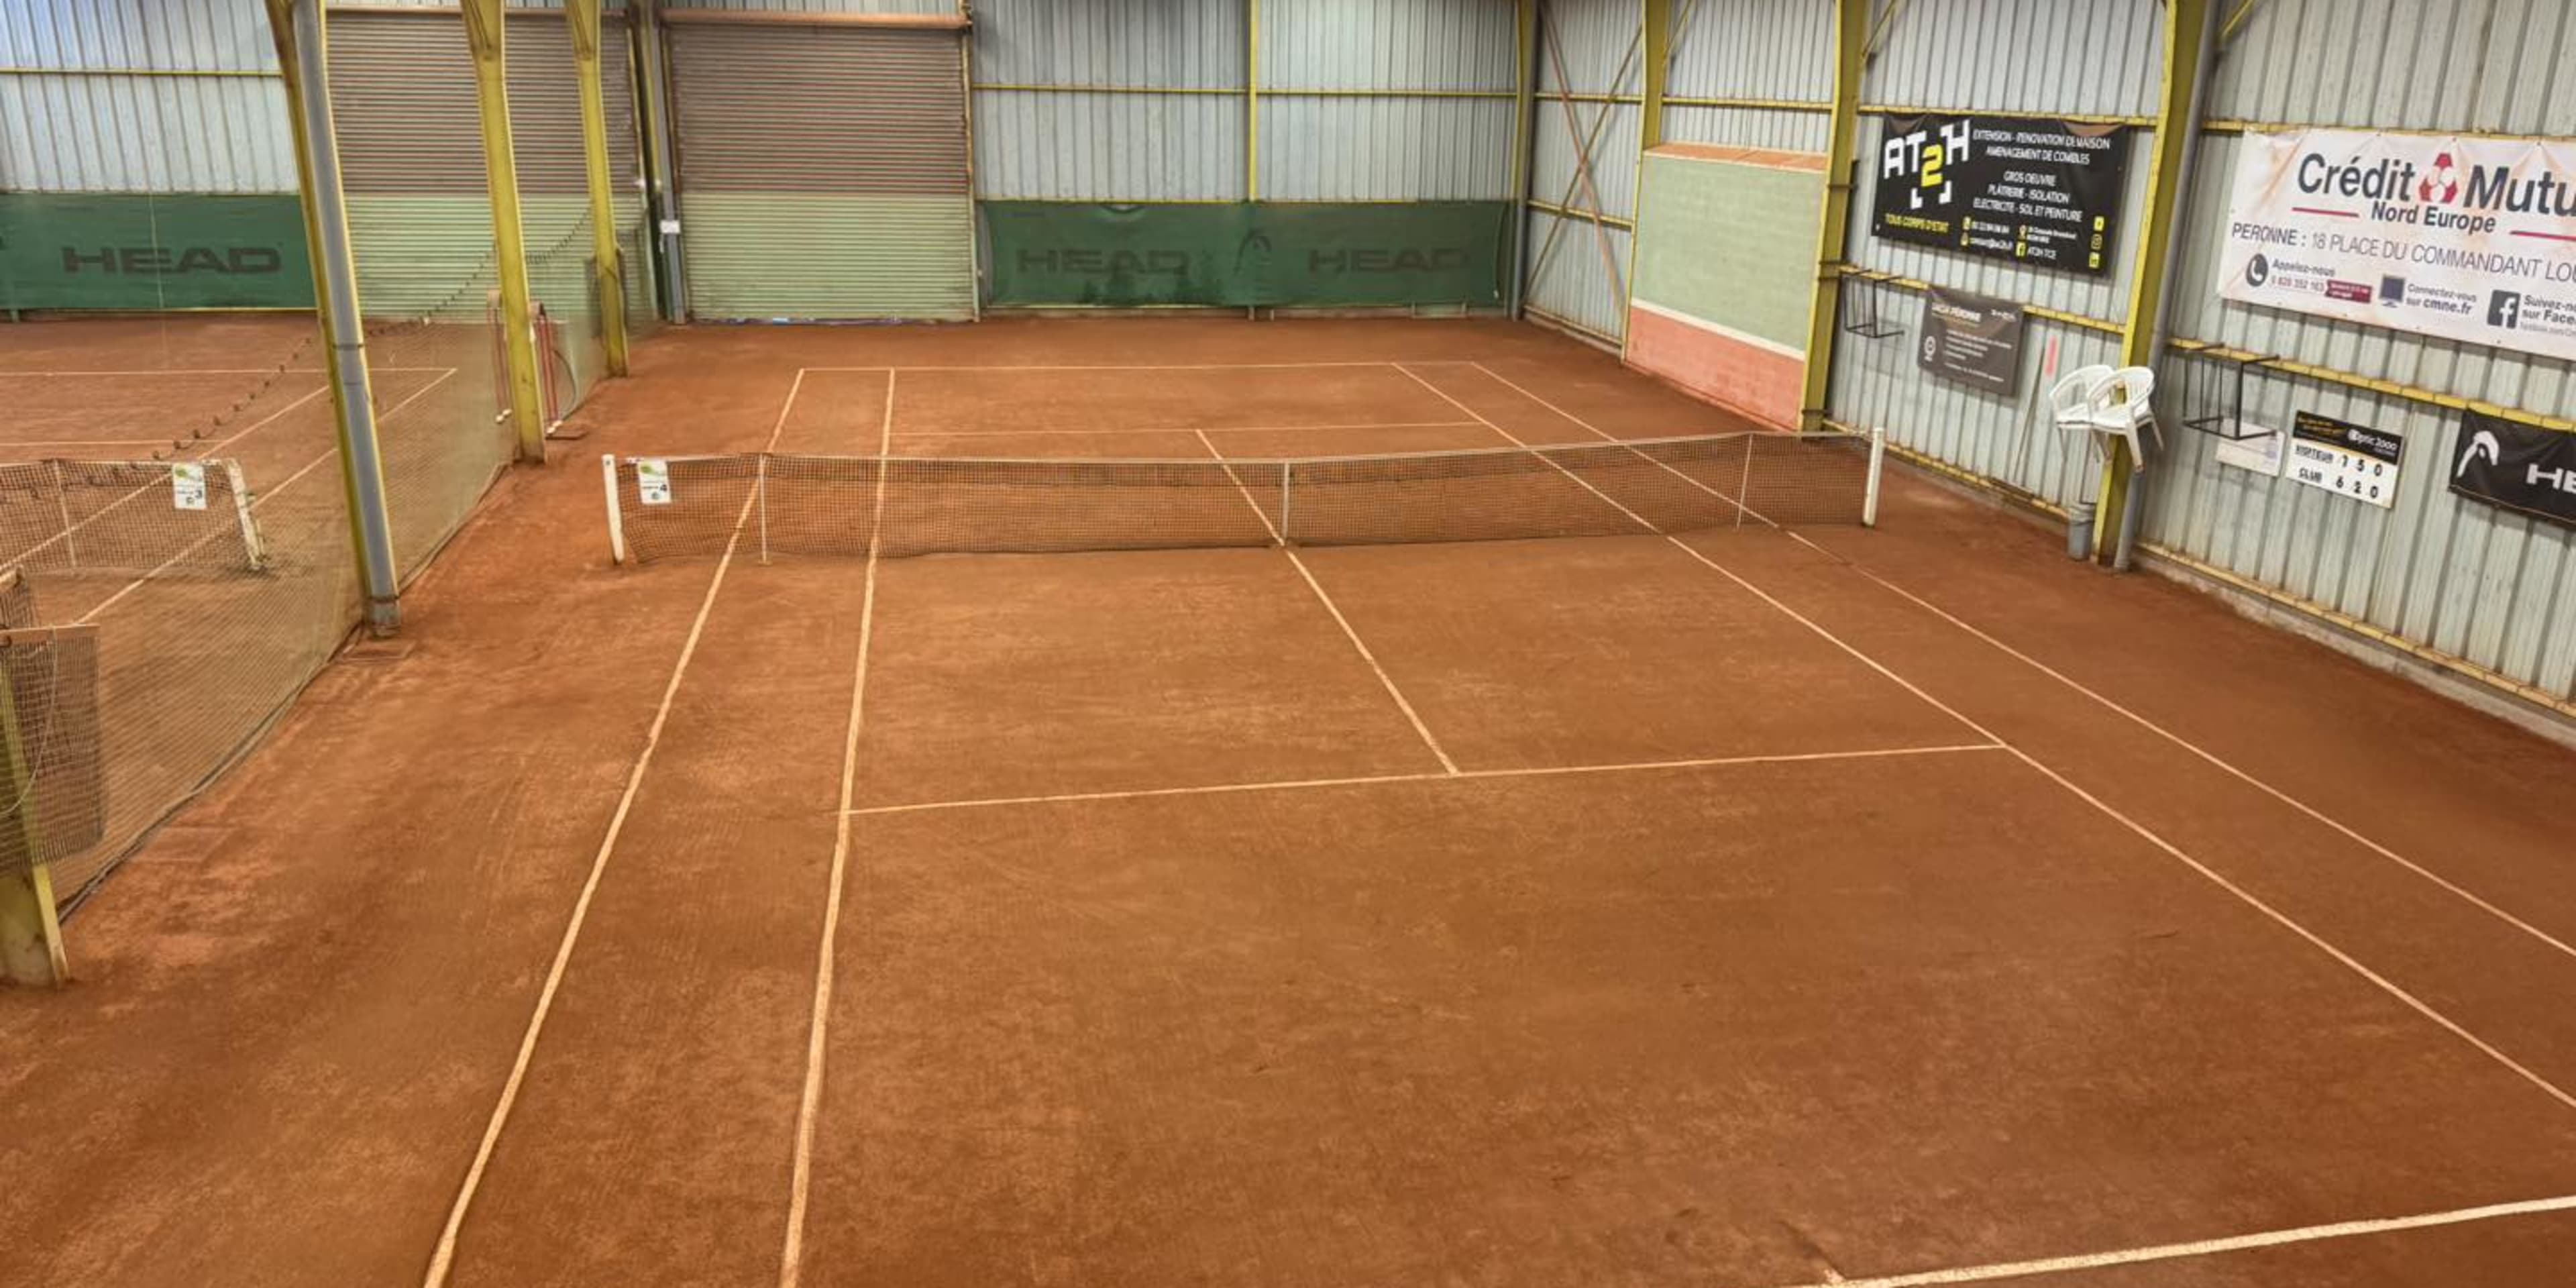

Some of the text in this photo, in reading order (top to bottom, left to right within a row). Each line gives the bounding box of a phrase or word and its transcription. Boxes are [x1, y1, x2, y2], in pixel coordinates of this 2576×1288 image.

[1972, 128, 2012, 142] EXTENSION
[2065, 137, 2076, 148] DE
[2077, 137, 2111, 150] MAISON
[1883, 119, 1970, 187] AT2H
[2042, 150, 2053, 162] DE
[2053, 151, 2090, 165] COMBLES
[2002, 170, 2057, 186] GROS OEUVRE
[2298, 152, 2576, 217] Crédit Mutu
[2029, 188, 2071, 204] ISOLATION
[1885, 213, 1902, 226] TOUS
[2019, 203, 2033, 215] SOL
[2034, 205, 2043, 217] ET
[2044, 206, 2083, 223] PEINTURE
[2371, 200, 2497, 235] Nord Europe
[62, 246, 281, 274] HEAD
[2232, 222, 2298, 246] PERONNE
[2312, 232, 2326, 250] 18
[2330, 233, 2381, 257] PLACE
[2382, 240, 2408, 260] DU
[2411, 244, 2542, 278] COMMANDANT
[2545, 260, 2576, 283] LO
[2407, 282, 2477, 303] Connectez-vous
[2422, 297, 2473, 315] cmne.fr
[2522, 309, 2541, 319] sur
[2356, 458, 2365, 472] 5
[2373, 463, 2383, 477] 0
[2336, 476, 2344, 489] 6
[2353, 480, 2362, 494] 2
[2369, 485, 2379, 498] 0
